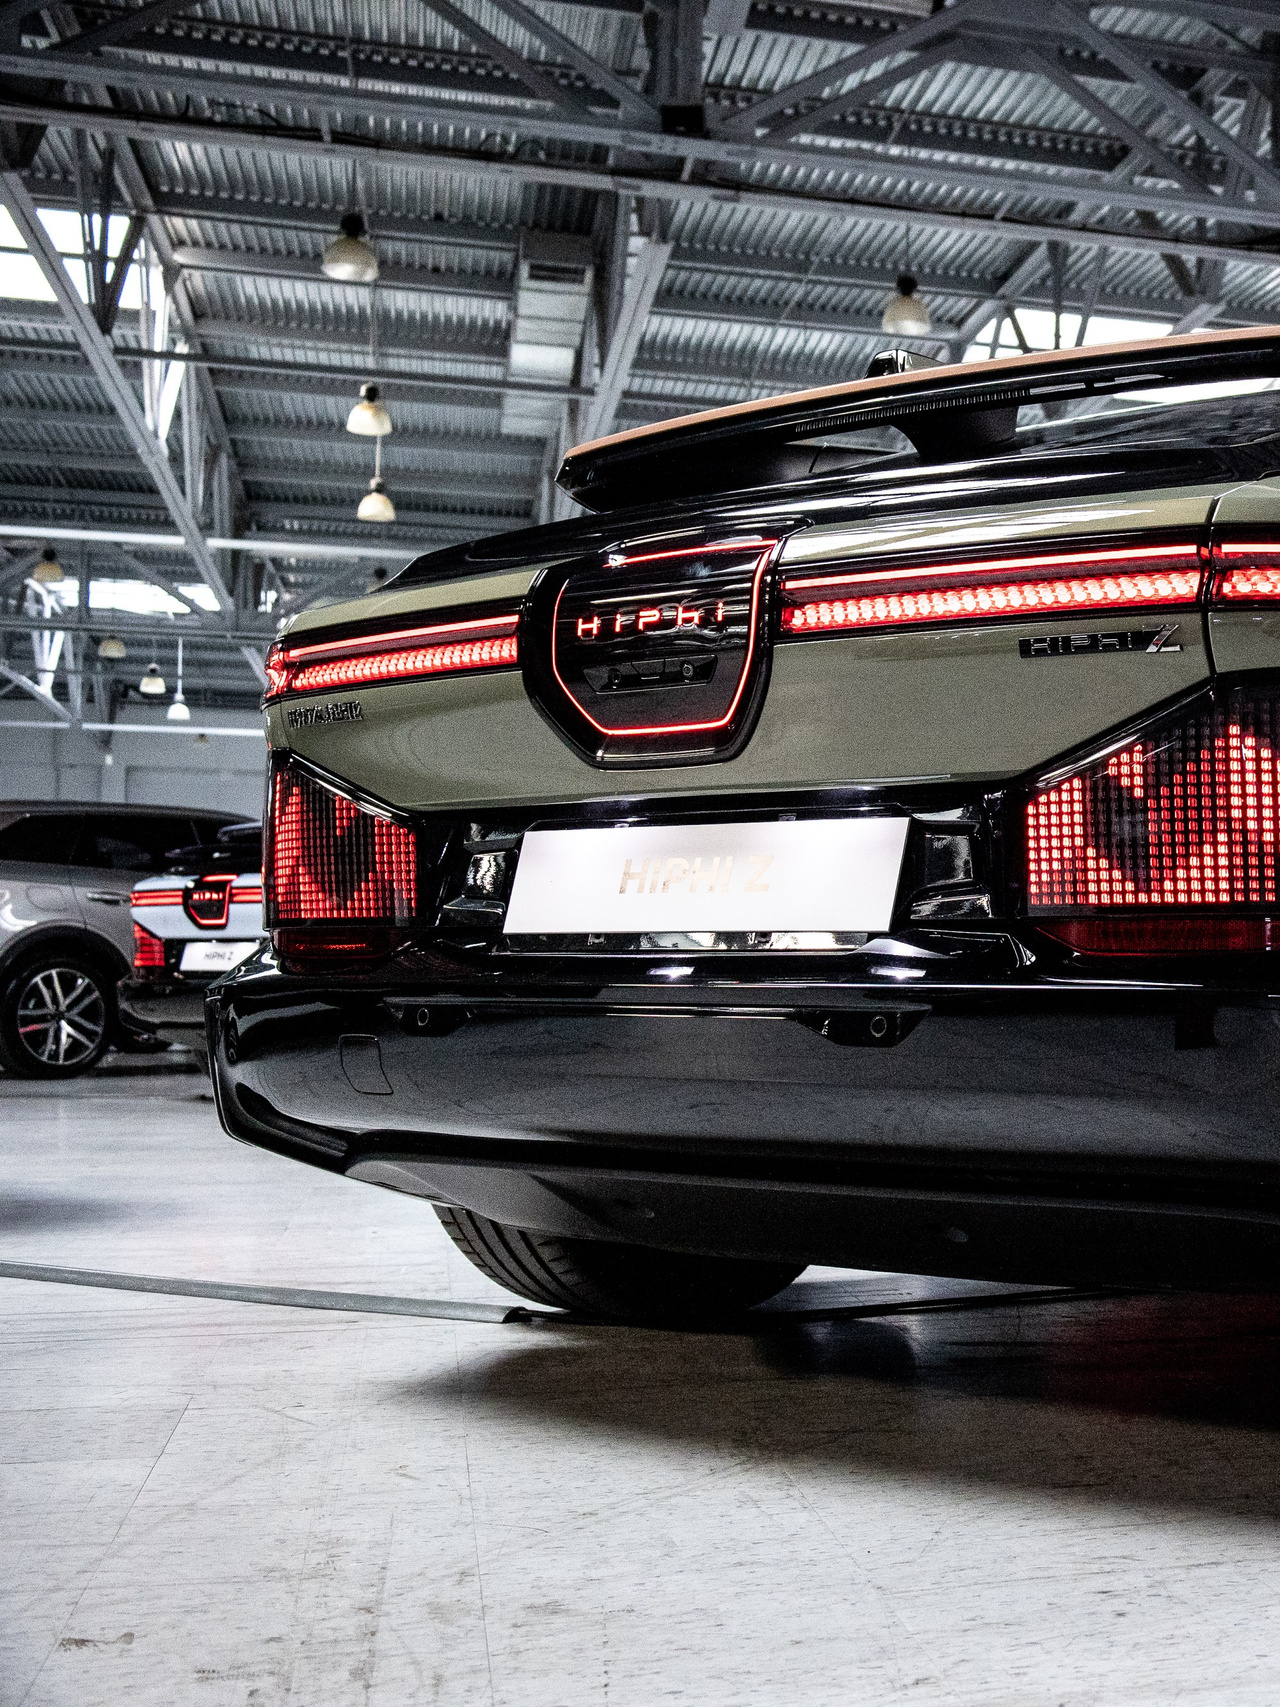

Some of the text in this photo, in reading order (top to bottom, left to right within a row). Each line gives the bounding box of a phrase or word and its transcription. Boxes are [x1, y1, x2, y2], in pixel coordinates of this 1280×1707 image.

[1141, 623, 1182, 653] Z
[618, 854, 775, 895] HIPHI Z
